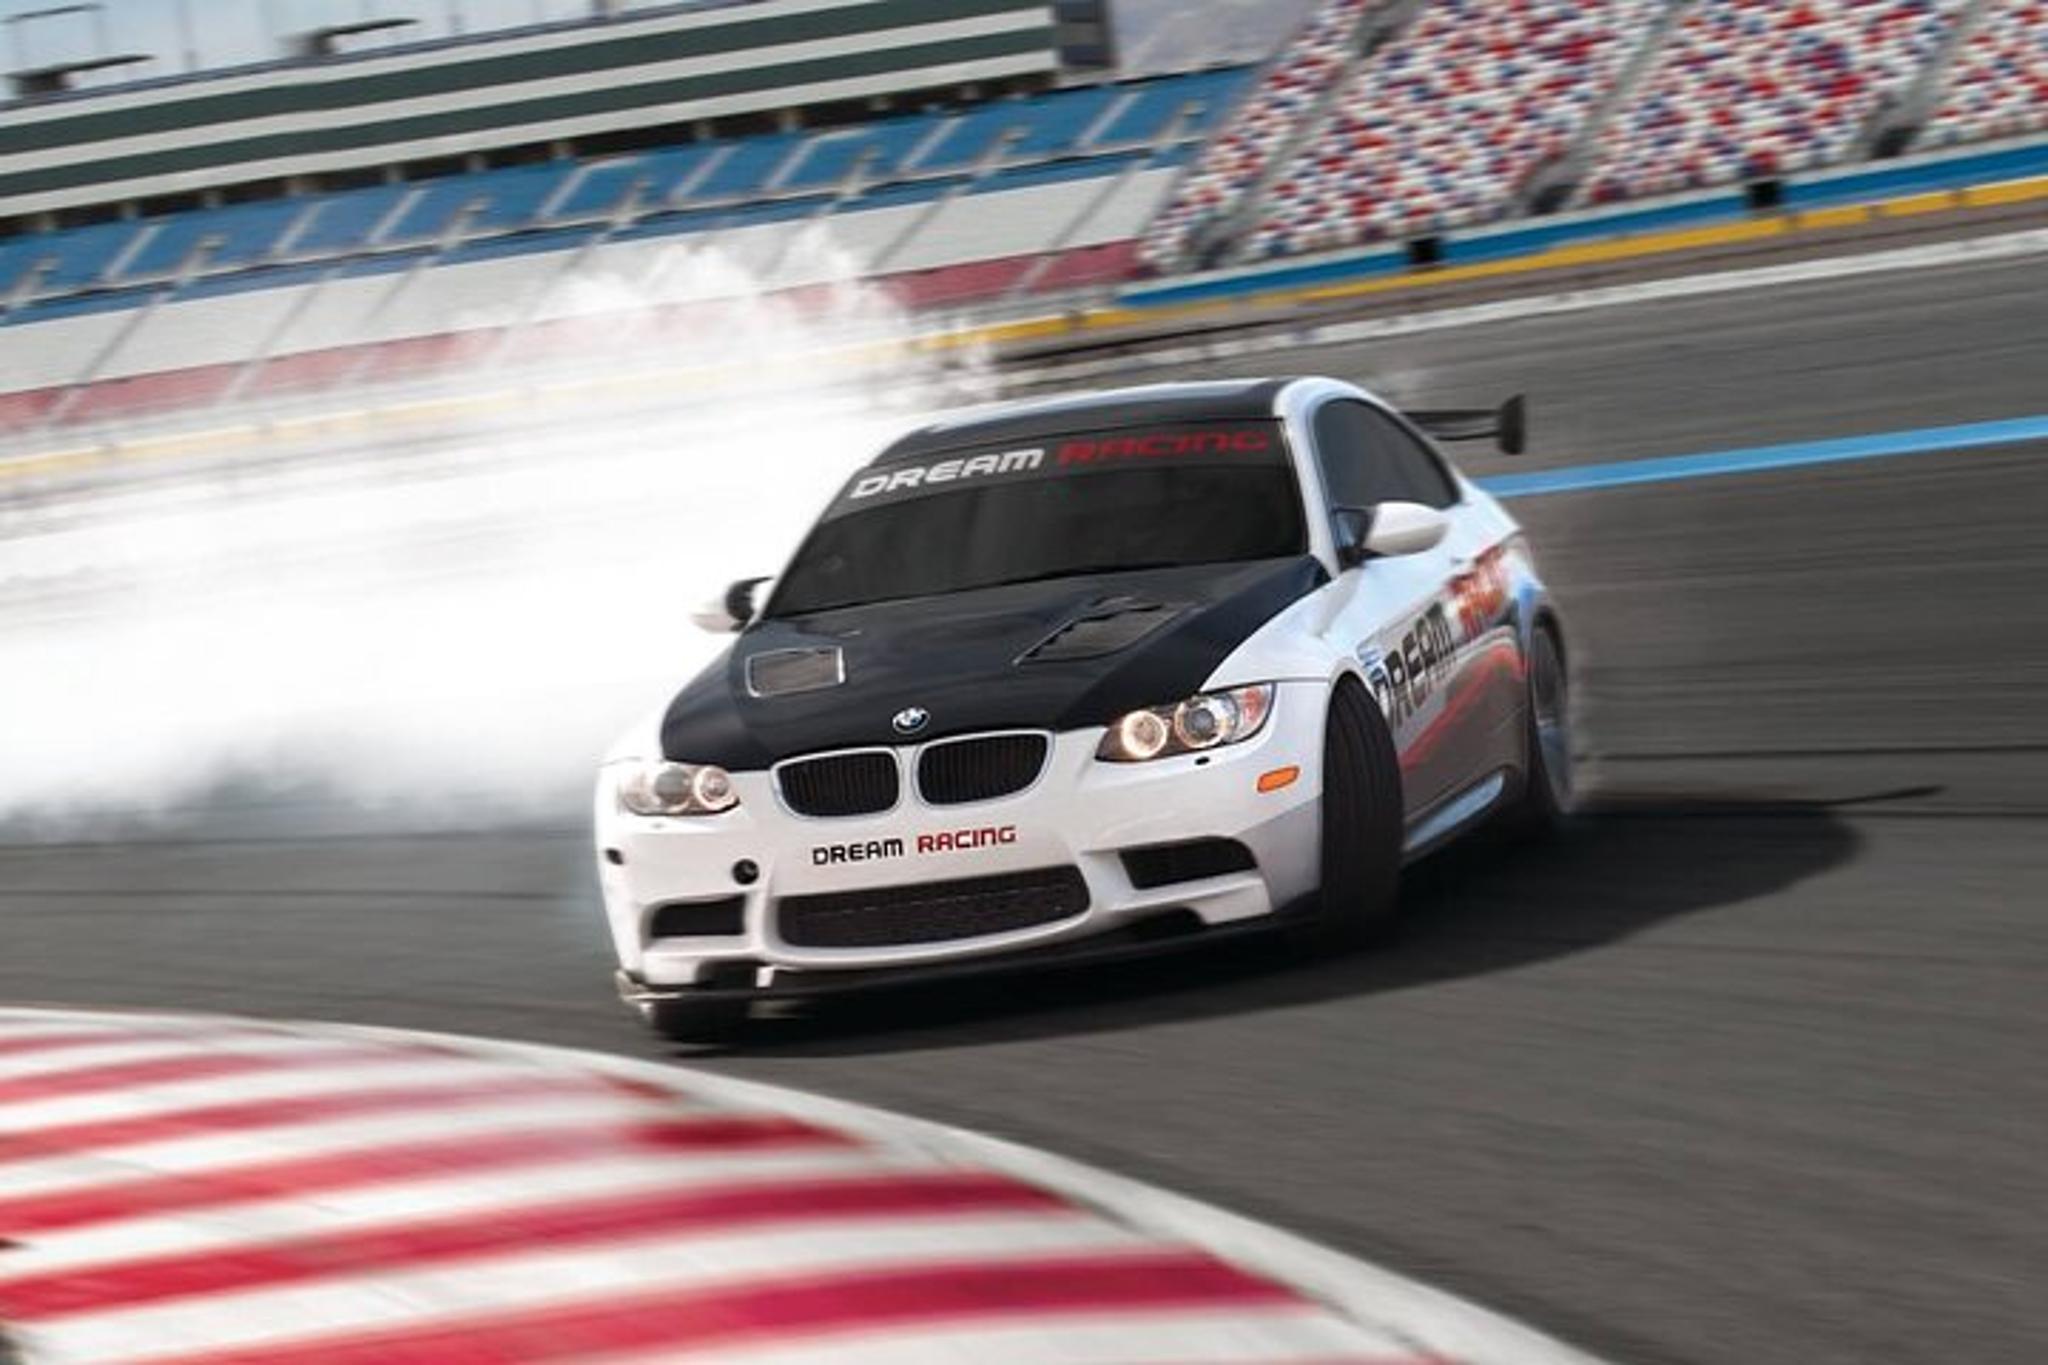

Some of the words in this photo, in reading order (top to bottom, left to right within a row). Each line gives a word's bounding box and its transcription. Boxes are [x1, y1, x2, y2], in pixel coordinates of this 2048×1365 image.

[850, 448, 1046, 499] DREAM
[1057, 431, 1269, 466] RACING
[812, 837, 904, 866] DREAM
[916, 826, 1017, 854] RACING
